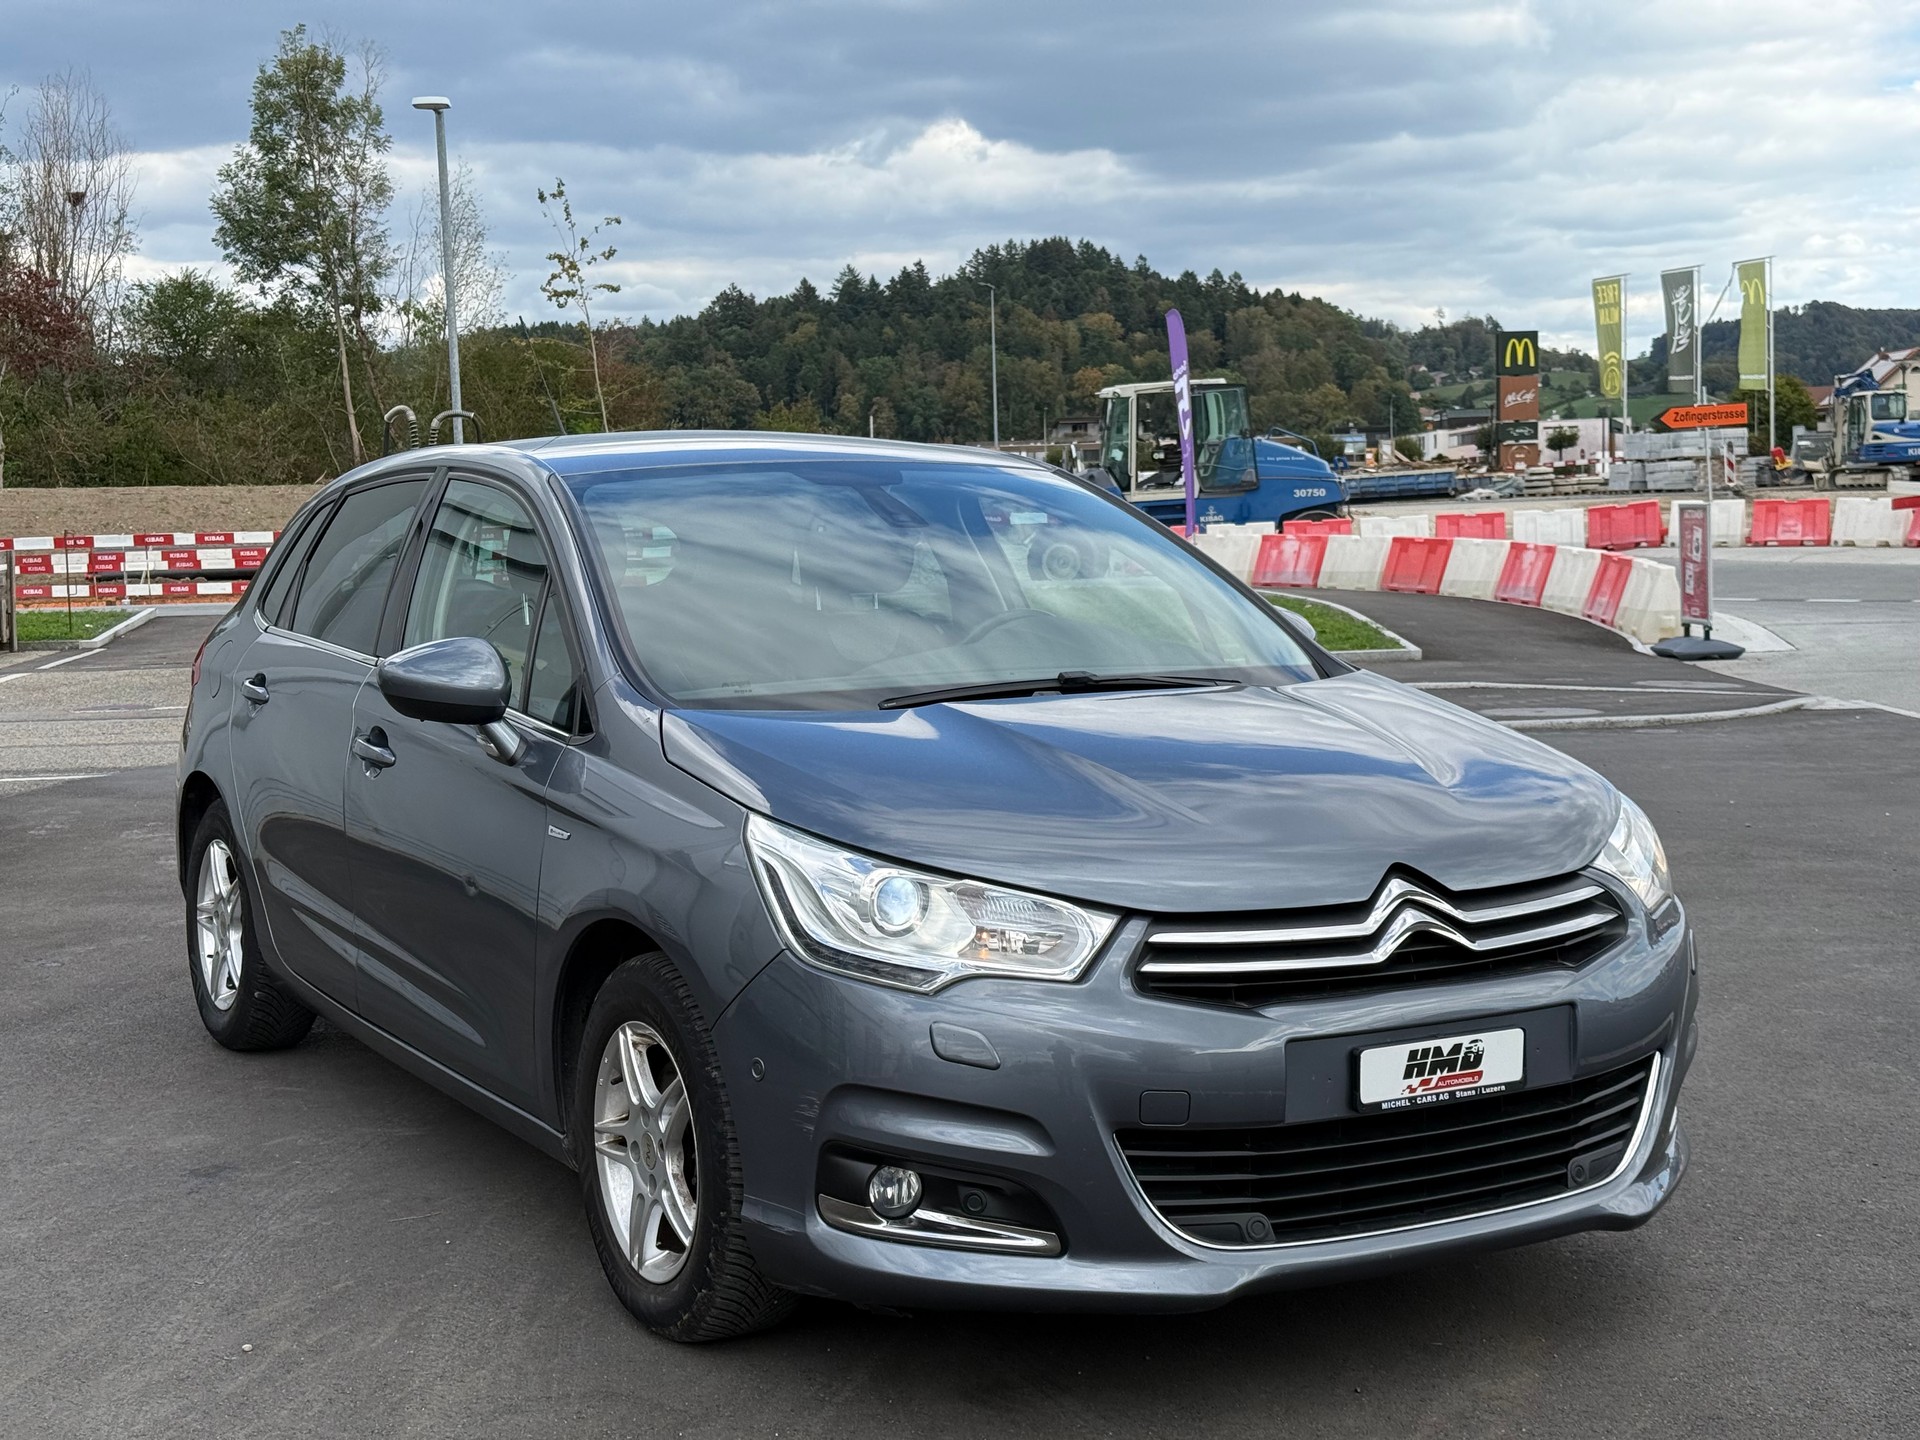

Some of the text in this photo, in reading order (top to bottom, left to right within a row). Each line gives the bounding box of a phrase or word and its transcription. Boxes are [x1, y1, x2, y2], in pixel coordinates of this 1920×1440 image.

[1673, 410, 1746, 423] Zofingerstrasse
[1293, 488, 1327, 498] 30750
[1199, 515, 1224, 523] KIBAG
[1437, 1076, 1479, 1087] AUTOMOBILE
[1381, 1098, 1411, 1110] MICHEL
[1416, 1095, 1437, 1104] CARS
[1439, 1093, 1450, 1101] AG
[1455, 1089, 1476, 1099] Stans
[1481, 1085, 1506, 1095] Luzern
